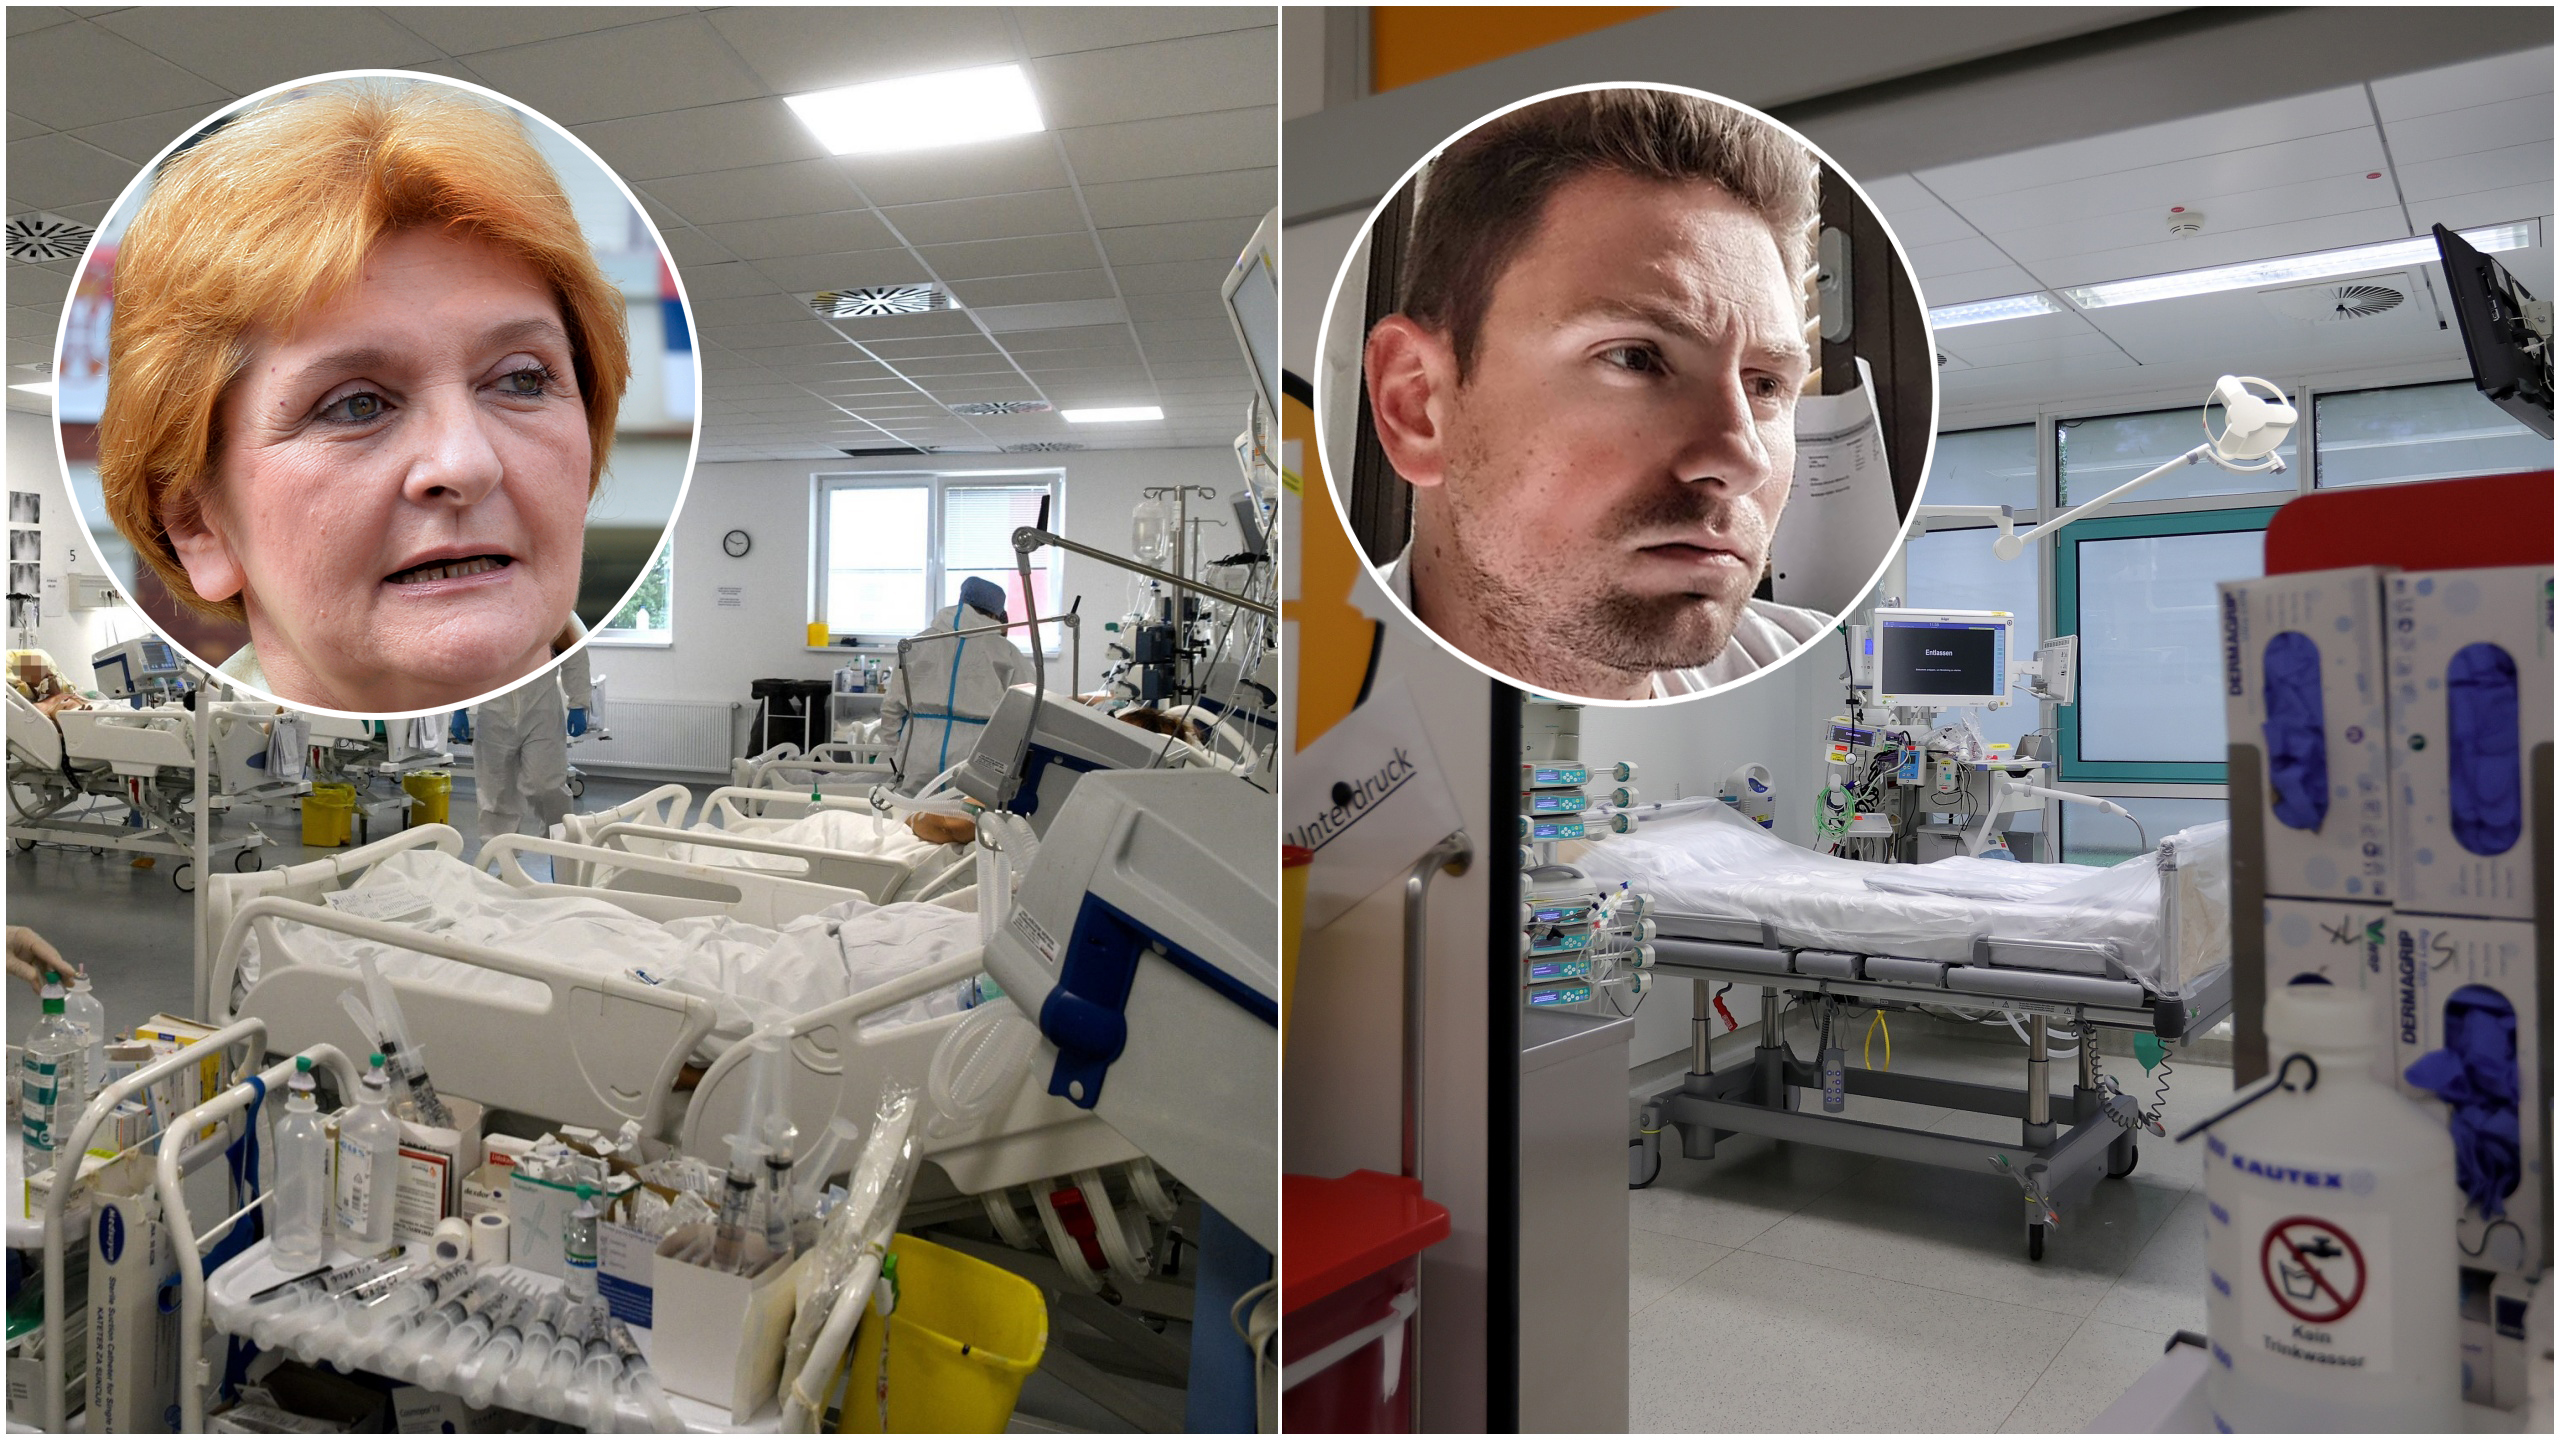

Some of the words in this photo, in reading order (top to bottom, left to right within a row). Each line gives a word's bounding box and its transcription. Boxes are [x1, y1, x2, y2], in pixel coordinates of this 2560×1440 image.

[69, 549, 76, 562] 5
[1925, 648, 1953, 657] Entlassen
[2398, 930, 2416, 1044] DERMAGRIP
[2231, 1153, 2342, 1189] KAUTEX
[108, 1276, 116, 1305] Sterile
[96, 1307, 104, 1351] KATETER
[108, 1307, 116, 1341] Suction
[107, 1344, 115, 1380] Catheter
[2264, 1334, 2365, 1368] Trinkwasser
[105, 1398, 113, 1425] Single
